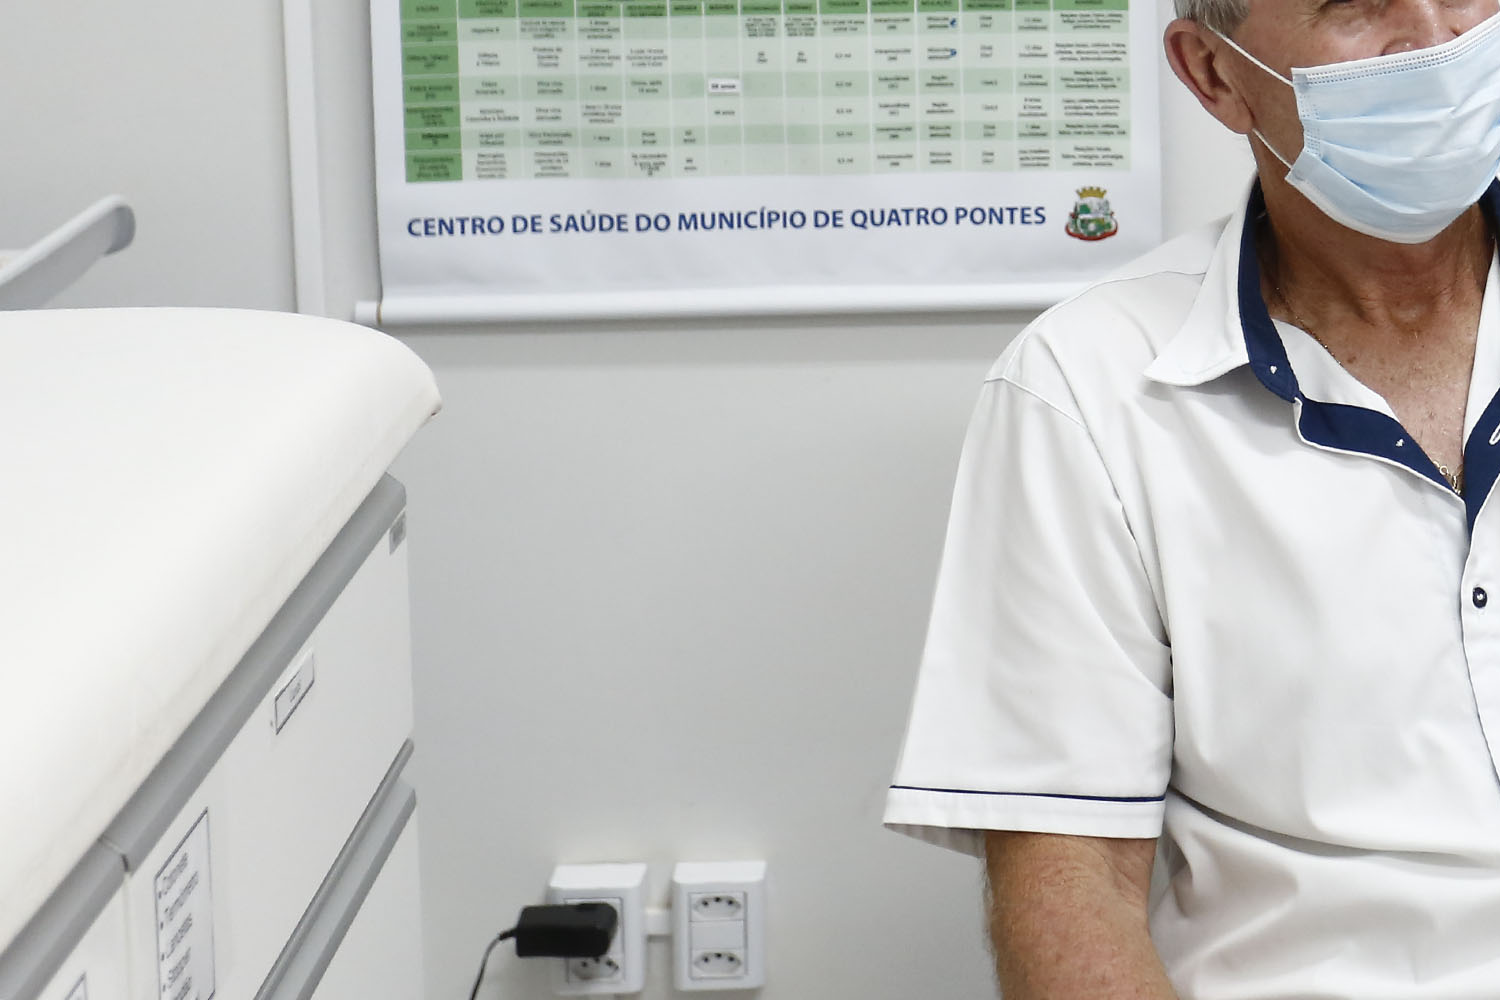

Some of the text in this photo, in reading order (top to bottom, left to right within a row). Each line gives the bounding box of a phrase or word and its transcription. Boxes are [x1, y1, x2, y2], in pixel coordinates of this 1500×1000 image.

[407, 206, 1046, 237] CENTRO DE SAÚDE DO MUNICÍPIO DE QUATRO PONTES
